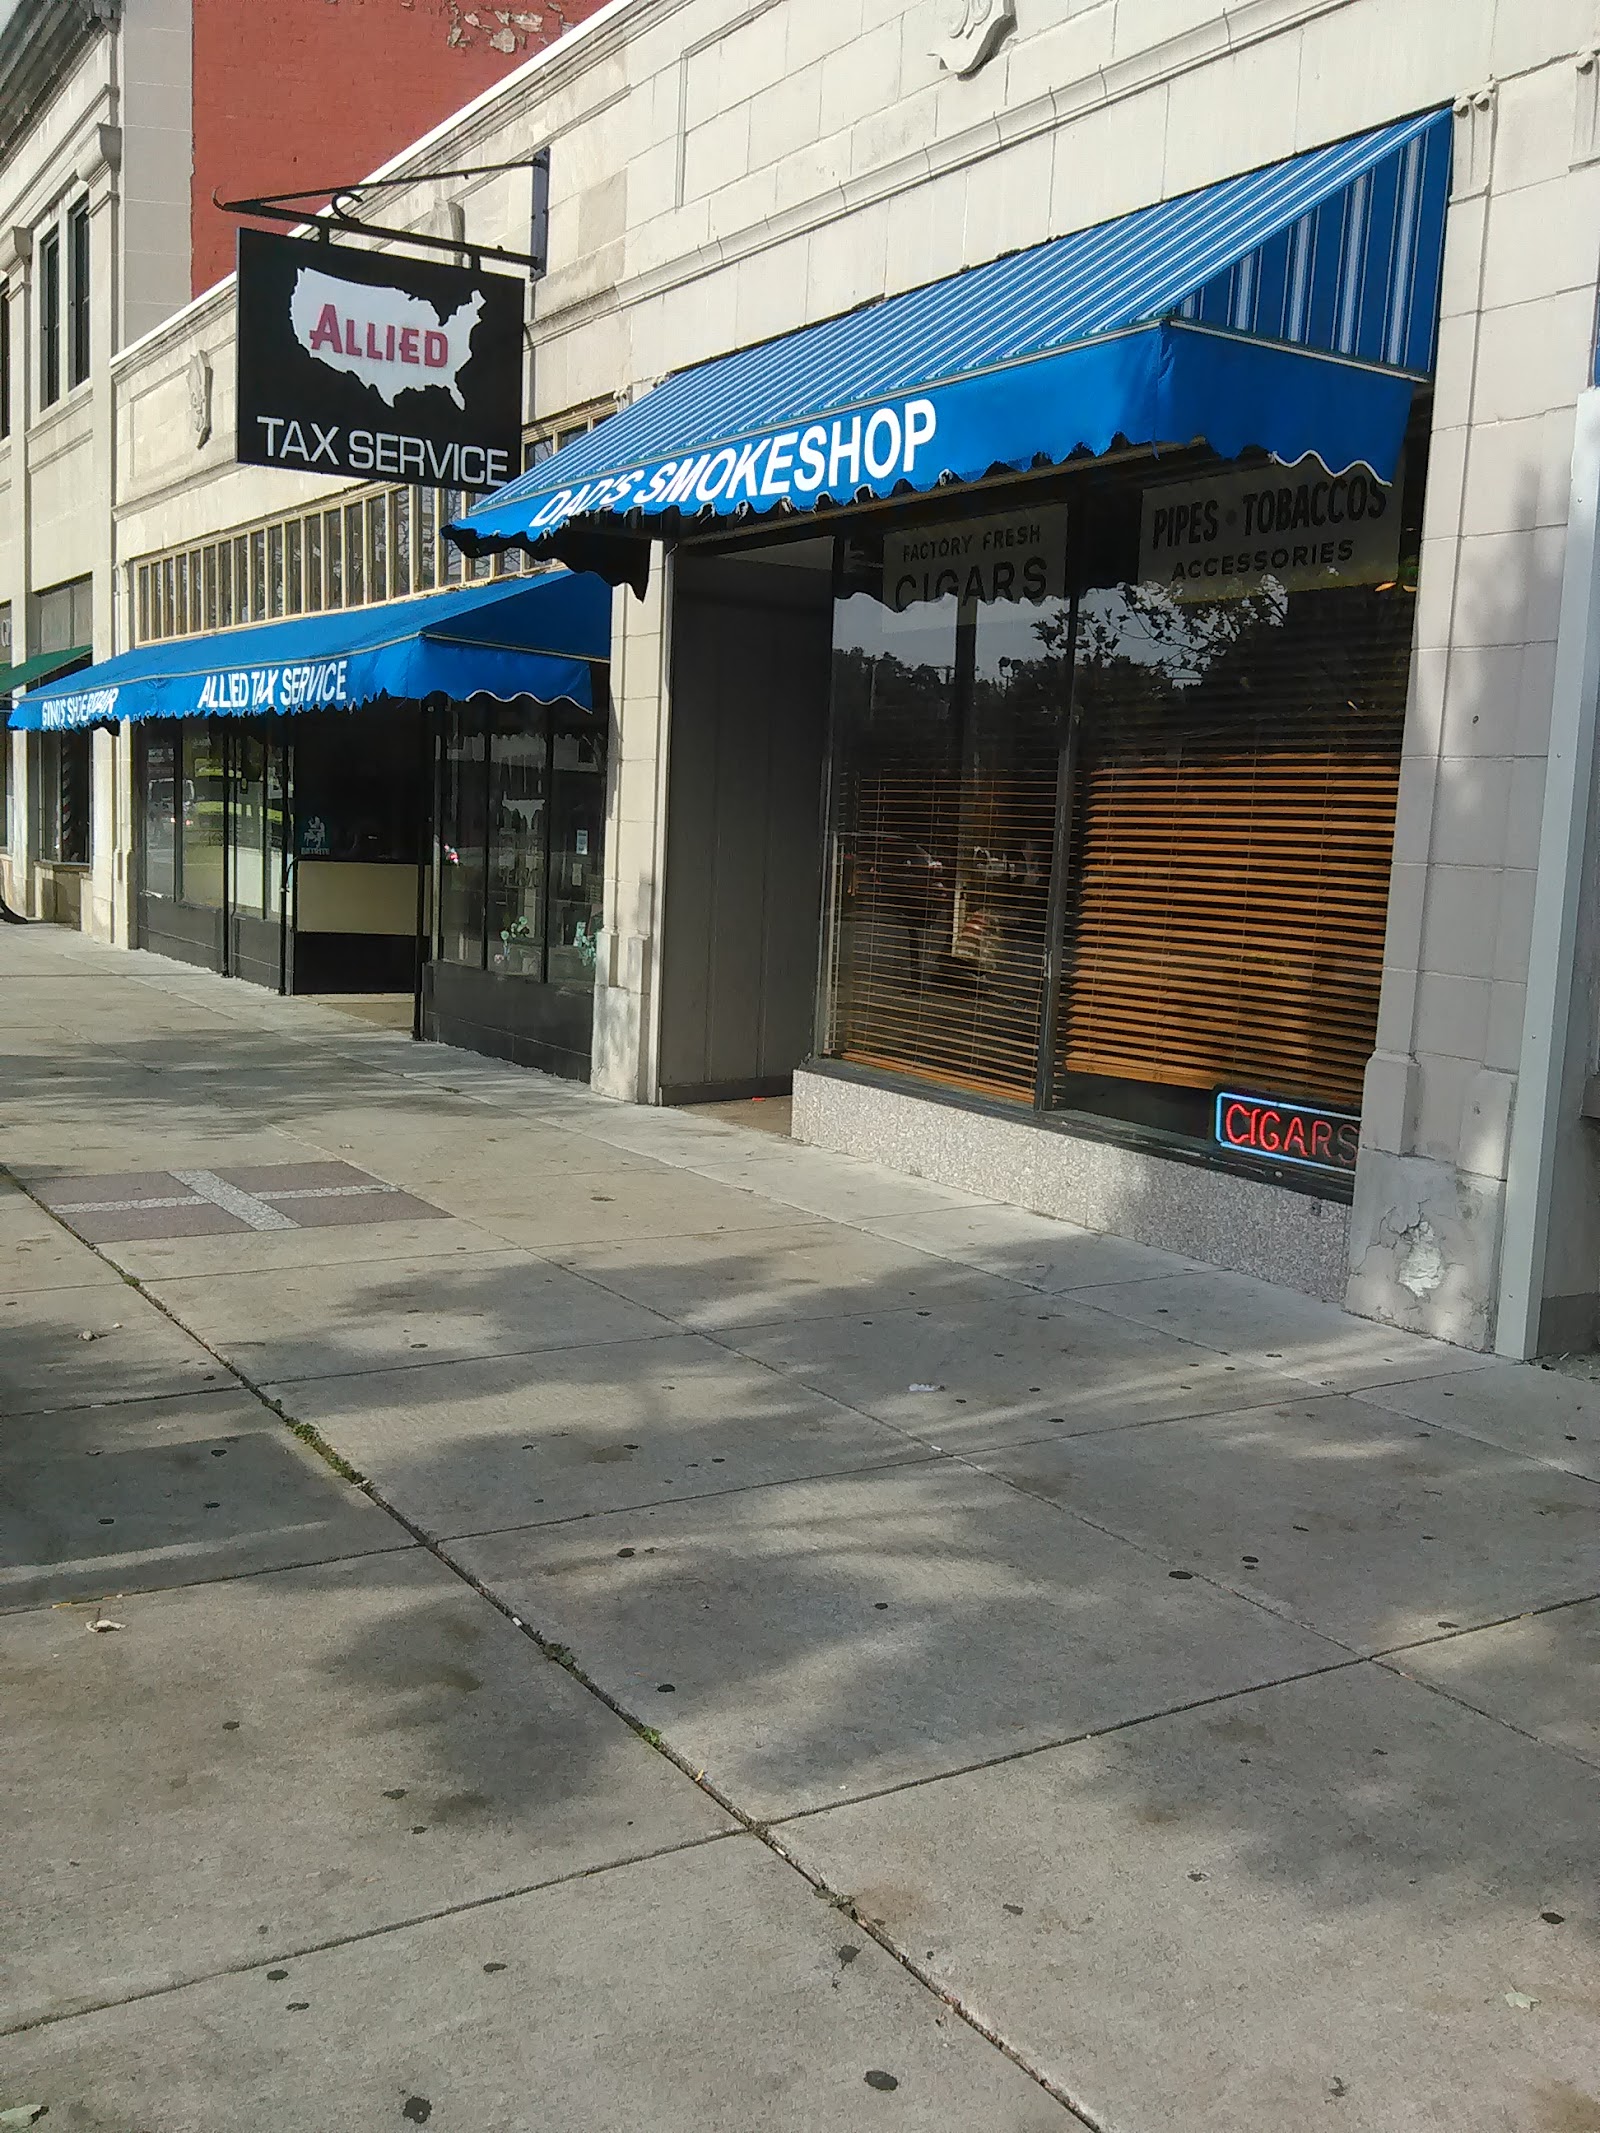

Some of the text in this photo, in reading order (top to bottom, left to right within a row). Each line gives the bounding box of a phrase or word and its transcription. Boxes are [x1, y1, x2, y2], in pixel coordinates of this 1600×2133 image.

[310, 303, 449, 368] ALLIED
[257, 416, 509, 487] TAX SERVICE
[529, 399, 937, 527] DAD'S SMOKESHOP
[1153, 475, 1387, 549] PIPES TOBACCOS
[903, 524, 1041, 563] FACTORY FRESH
[1171, 539, 1354, 582] ACCESSORIES
[895, 556, 1048, 614] CIGARS
[197, 660, 348, 708] ALLIED TAX SERVICE
[1225, 1103, 1358, 1165] CIGARS
